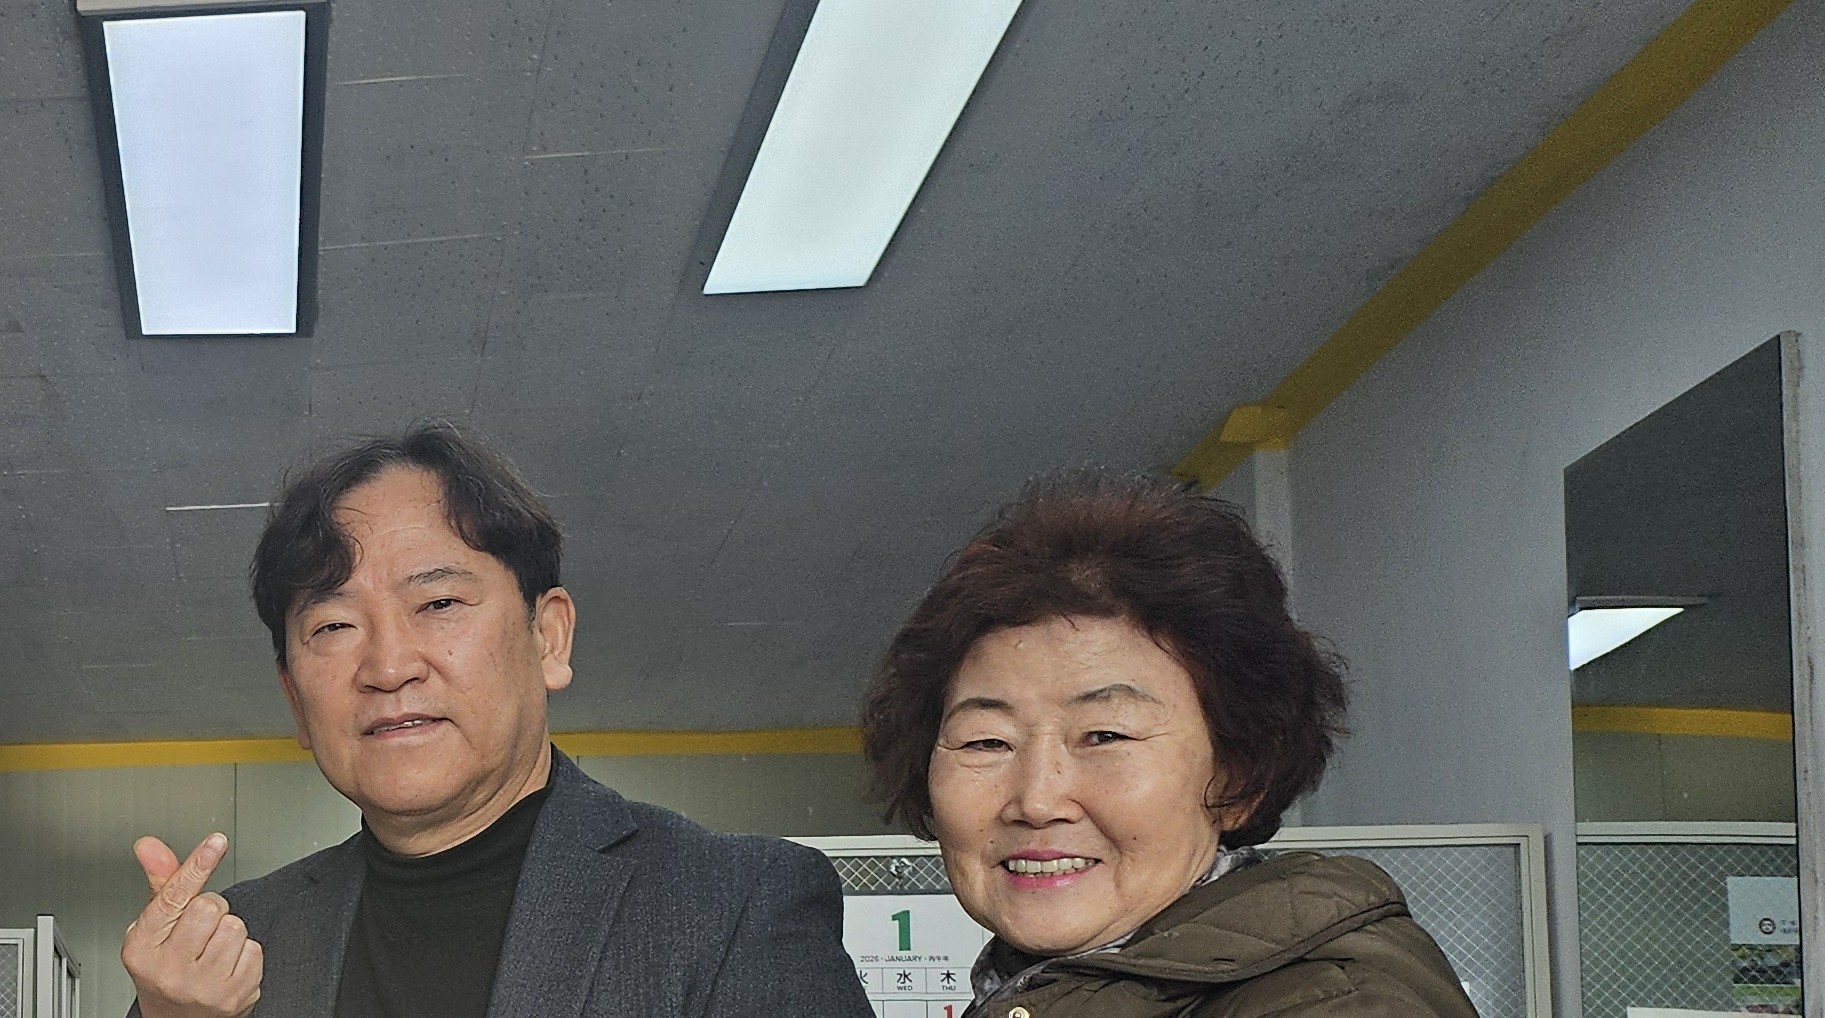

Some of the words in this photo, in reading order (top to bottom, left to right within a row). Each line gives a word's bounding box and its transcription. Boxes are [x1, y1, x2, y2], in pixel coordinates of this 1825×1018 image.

[891, 909, 912, 952] 1
[884, 955, 923, 963] JANUARY
[896, 969, 913, 985] 水
[940, 969, 957, 985] 木
